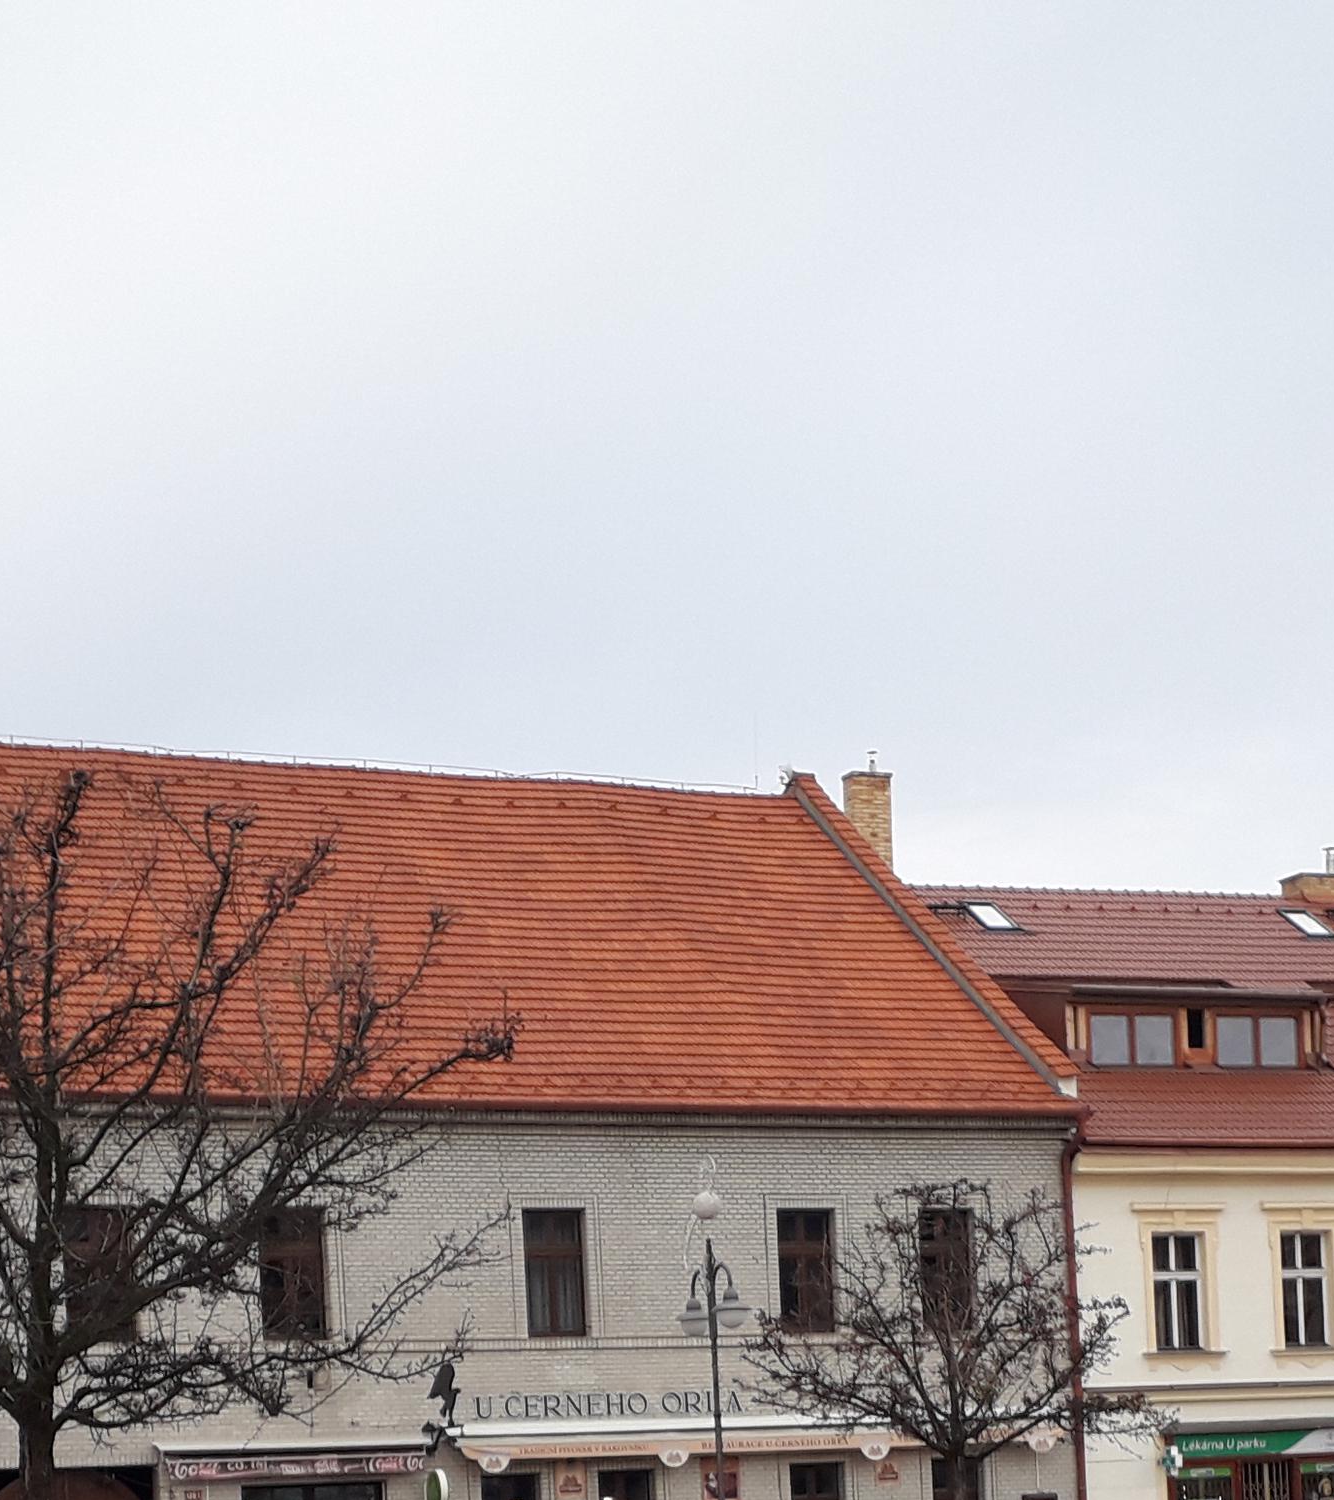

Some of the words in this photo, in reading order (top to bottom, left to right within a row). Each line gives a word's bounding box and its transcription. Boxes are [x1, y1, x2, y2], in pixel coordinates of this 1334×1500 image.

[474, 1396, 492, 1419] U
[701, 1439, 764, 1450] REAURACE
[1182, 1438, 1223, 1451] Lékárna
[1226, 1439, 1235, 1449] U
[1236, 1437, 1266, 1450] parku
